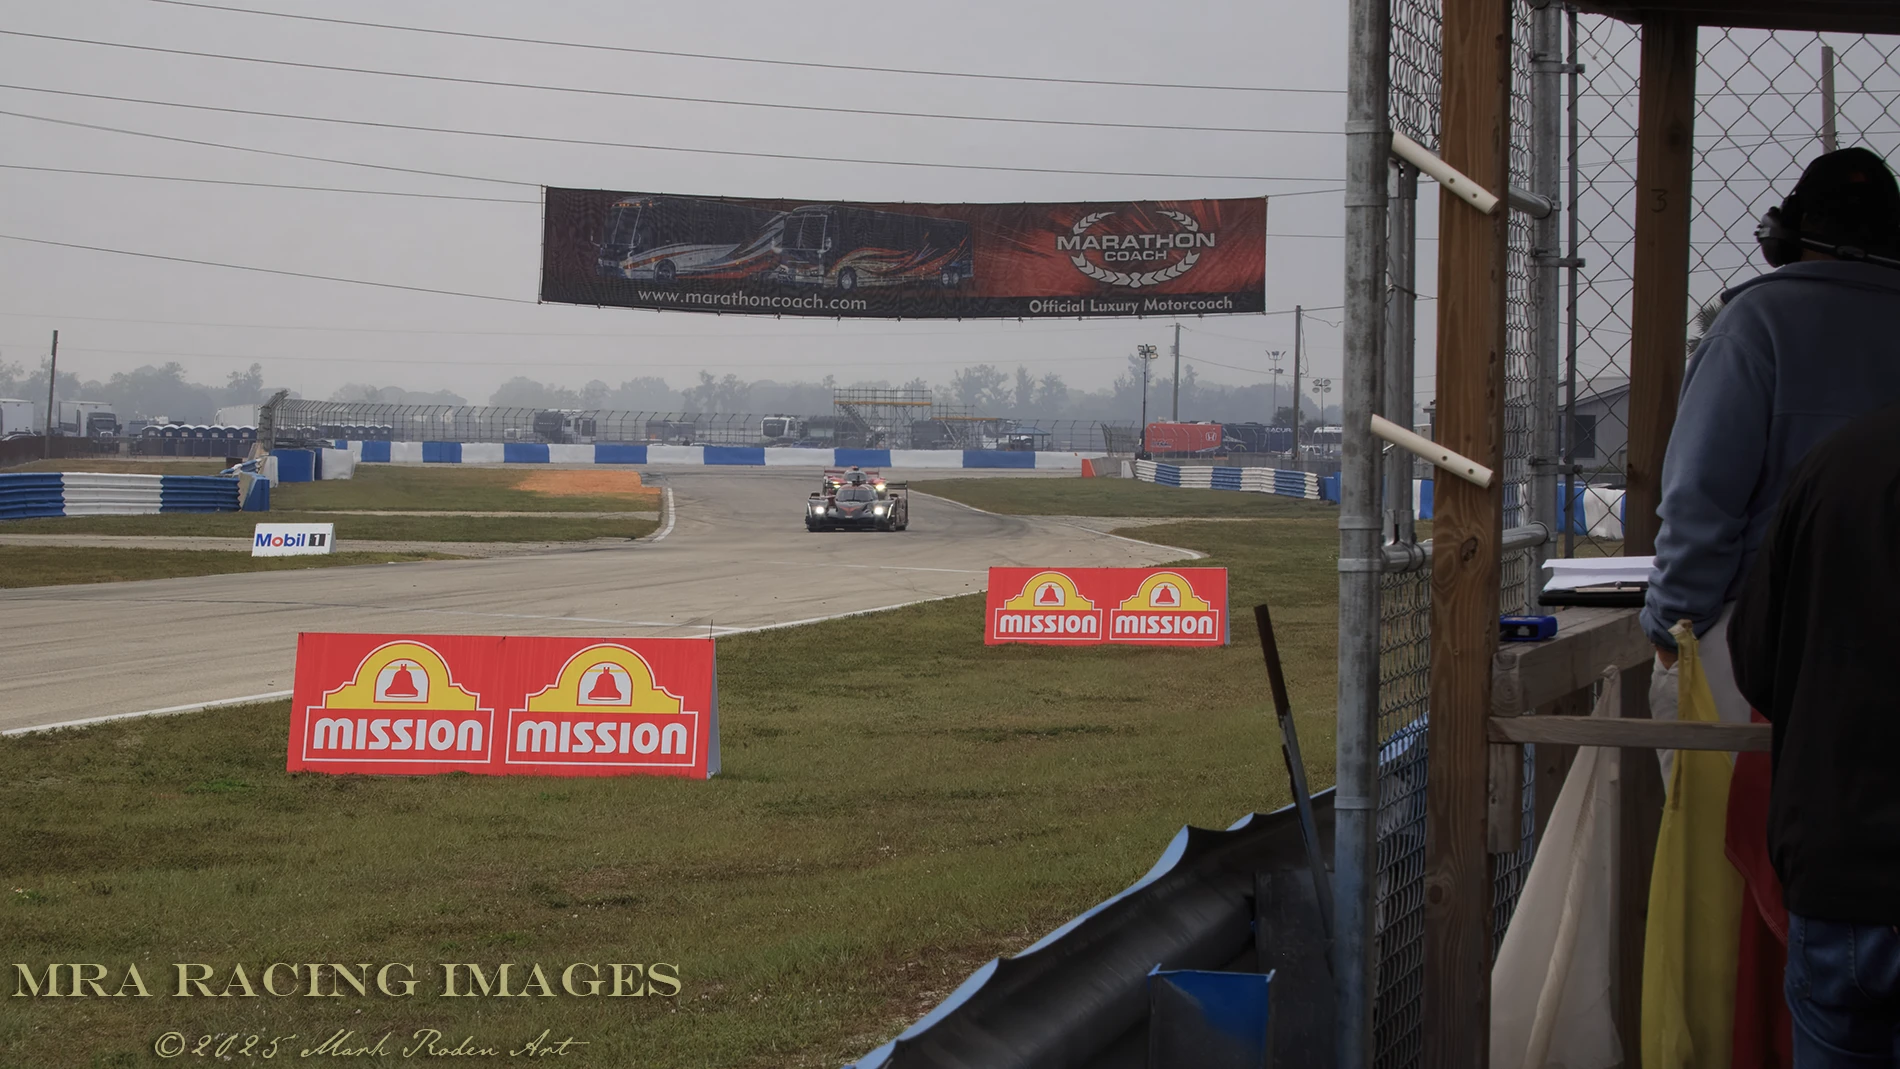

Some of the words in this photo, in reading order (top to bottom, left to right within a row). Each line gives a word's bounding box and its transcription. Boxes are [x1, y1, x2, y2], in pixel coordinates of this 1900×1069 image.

[1650, 188, 1668, 213] 3
[1057, 232, 1215, 250] MARATHON
[1104, 250, 1168, 262] COACH
[638, 290, 867, 310] www.marathoncoach.com
[1029, 299, 1085, 314] Official
[1091, 298, 1139, 315] Luxury
[1144, 296, 1233, 312] Motorcoach
[255, 533, 306, 547] Mobil
